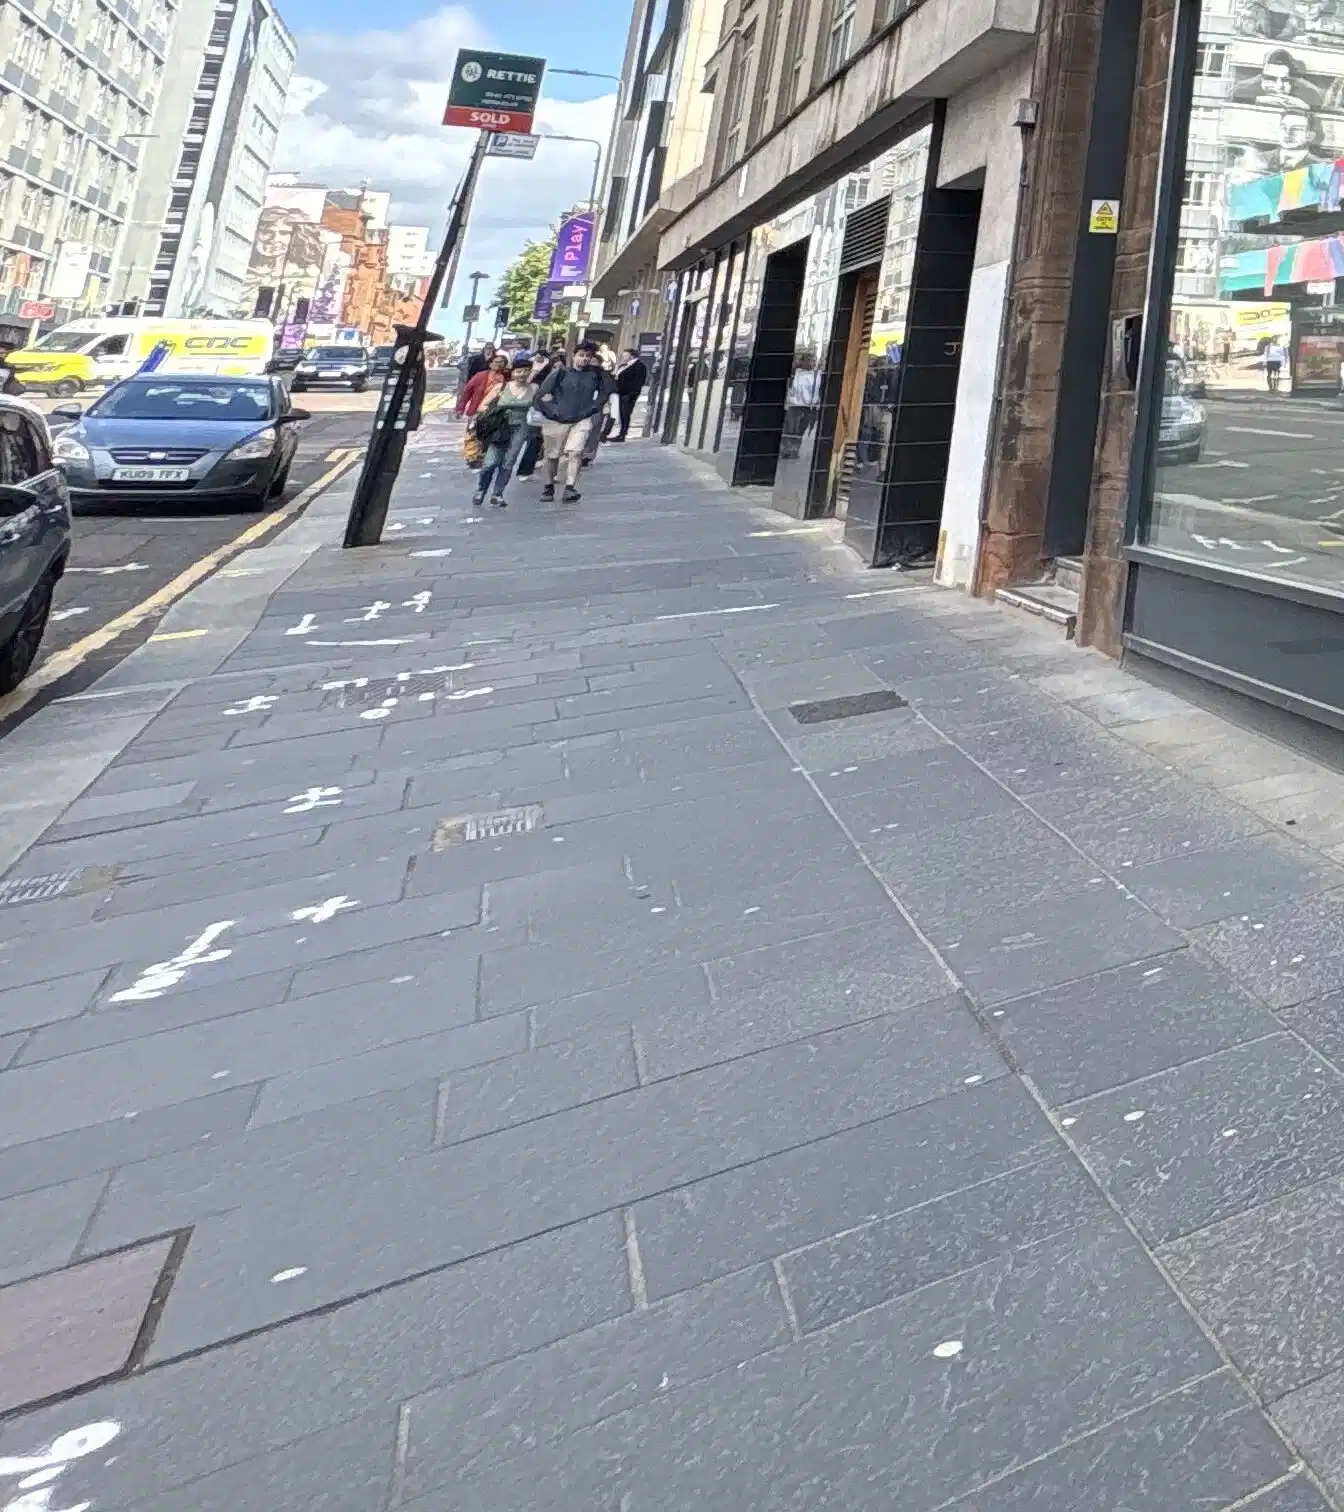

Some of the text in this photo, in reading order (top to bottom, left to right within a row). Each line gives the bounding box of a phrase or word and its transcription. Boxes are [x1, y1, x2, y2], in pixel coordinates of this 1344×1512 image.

[486, 68, 537, 84] RETTIE
[469, 111, 511, 125] SOLD
[563, 223, 589, 261] Play
